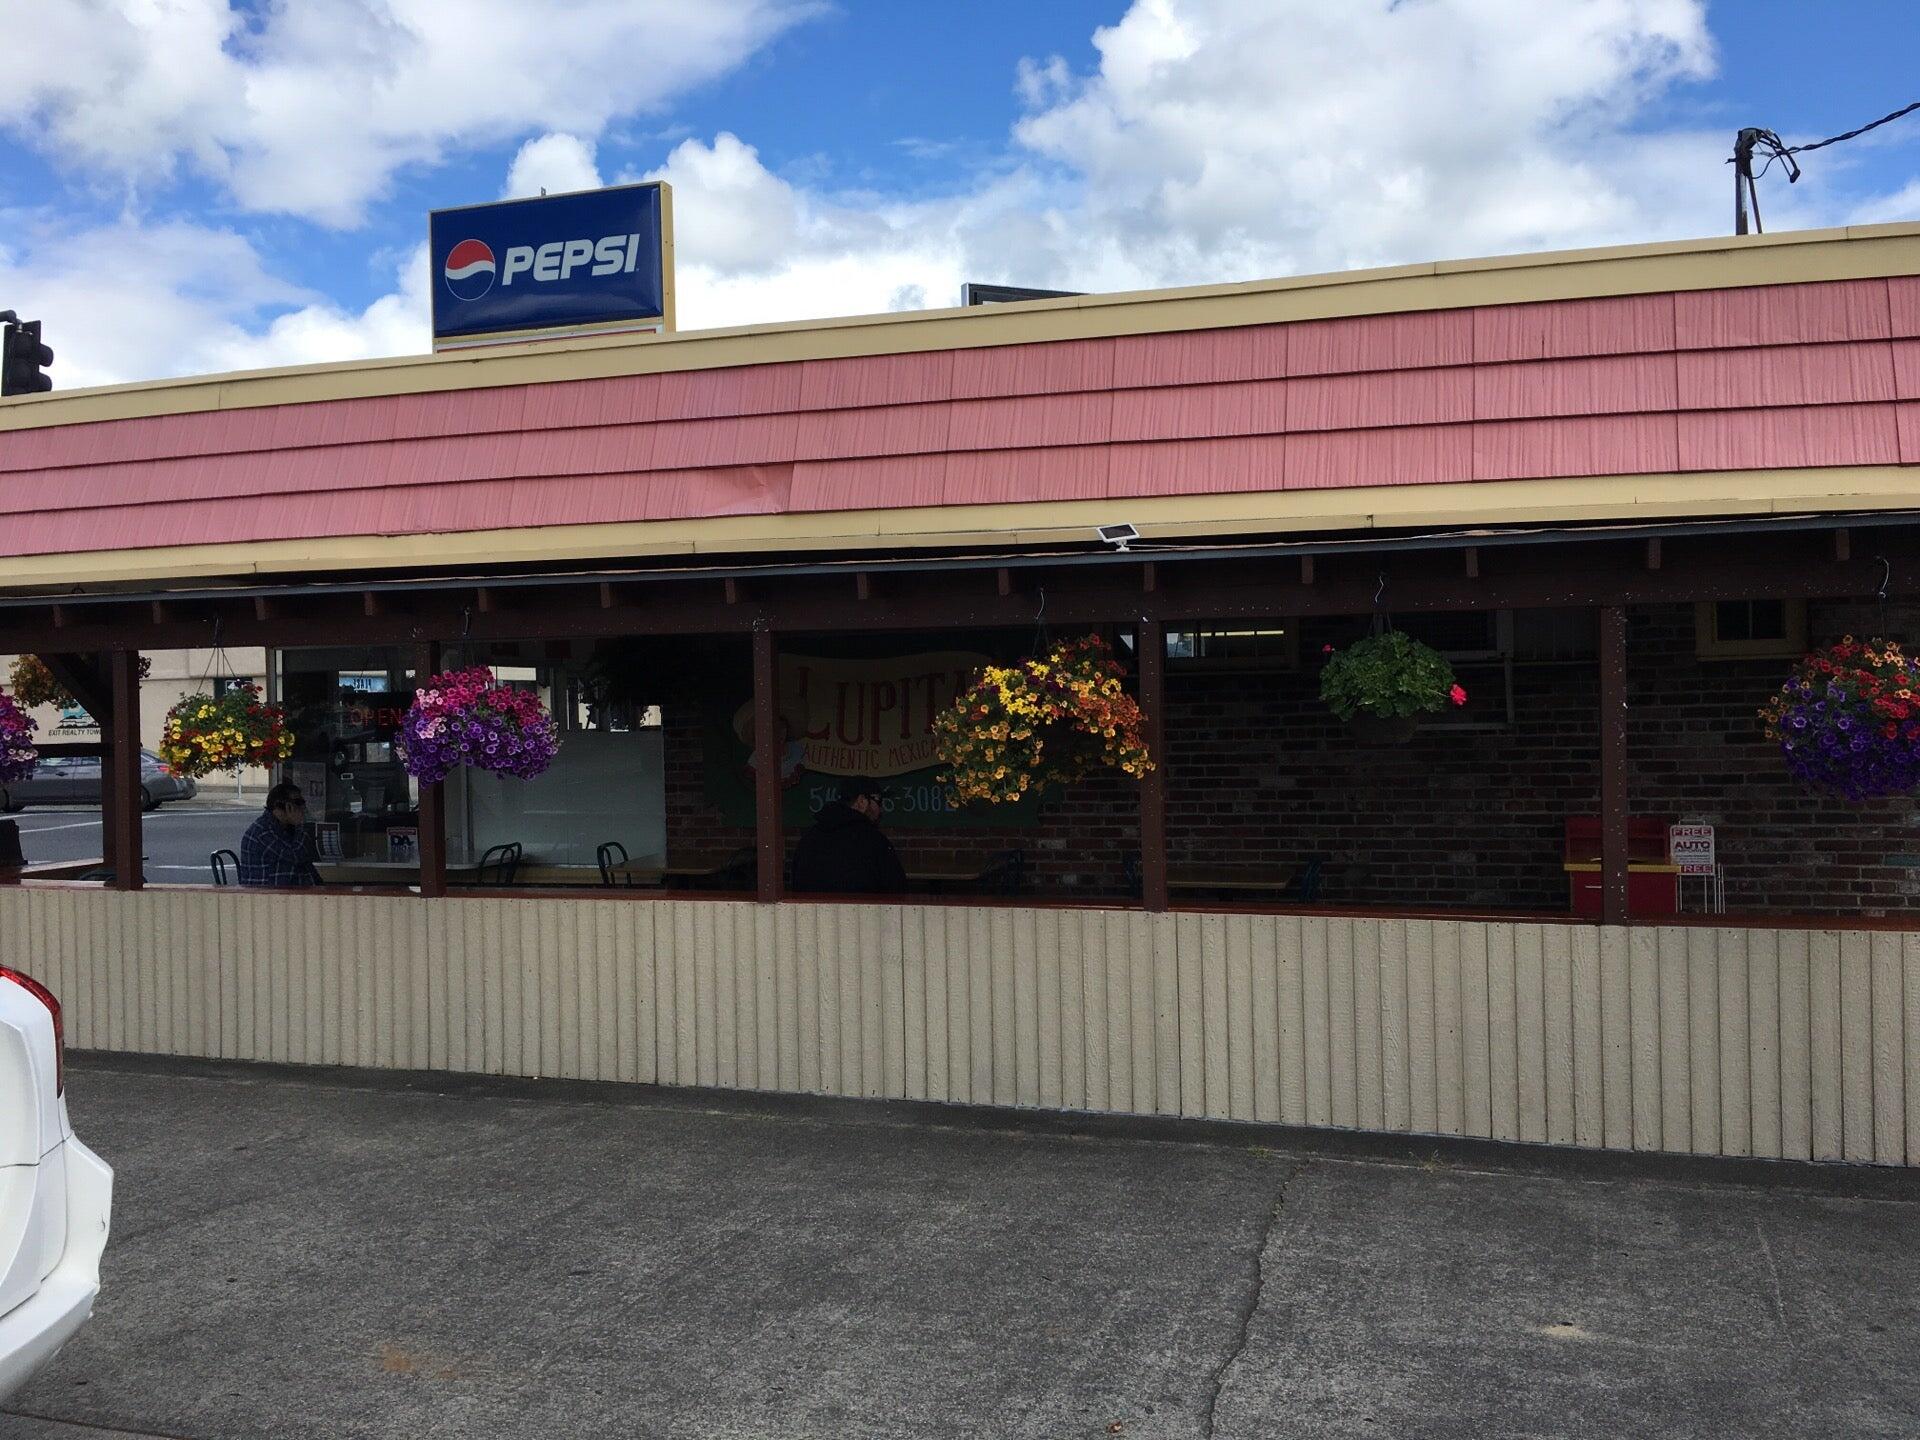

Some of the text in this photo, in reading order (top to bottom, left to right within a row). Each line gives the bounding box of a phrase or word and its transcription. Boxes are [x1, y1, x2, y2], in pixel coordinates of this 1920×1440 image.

[502, 233, 640, 286] PEPSI
[86, 728, 102, 736] TOW
[803, 738, 939, 770] AUTHENTIC MEXICA
[1673, 828, 1711, 836] FREE
[1675, 841, 1710, 849] AUTO
[1683, 865, 1711, 873] REE
